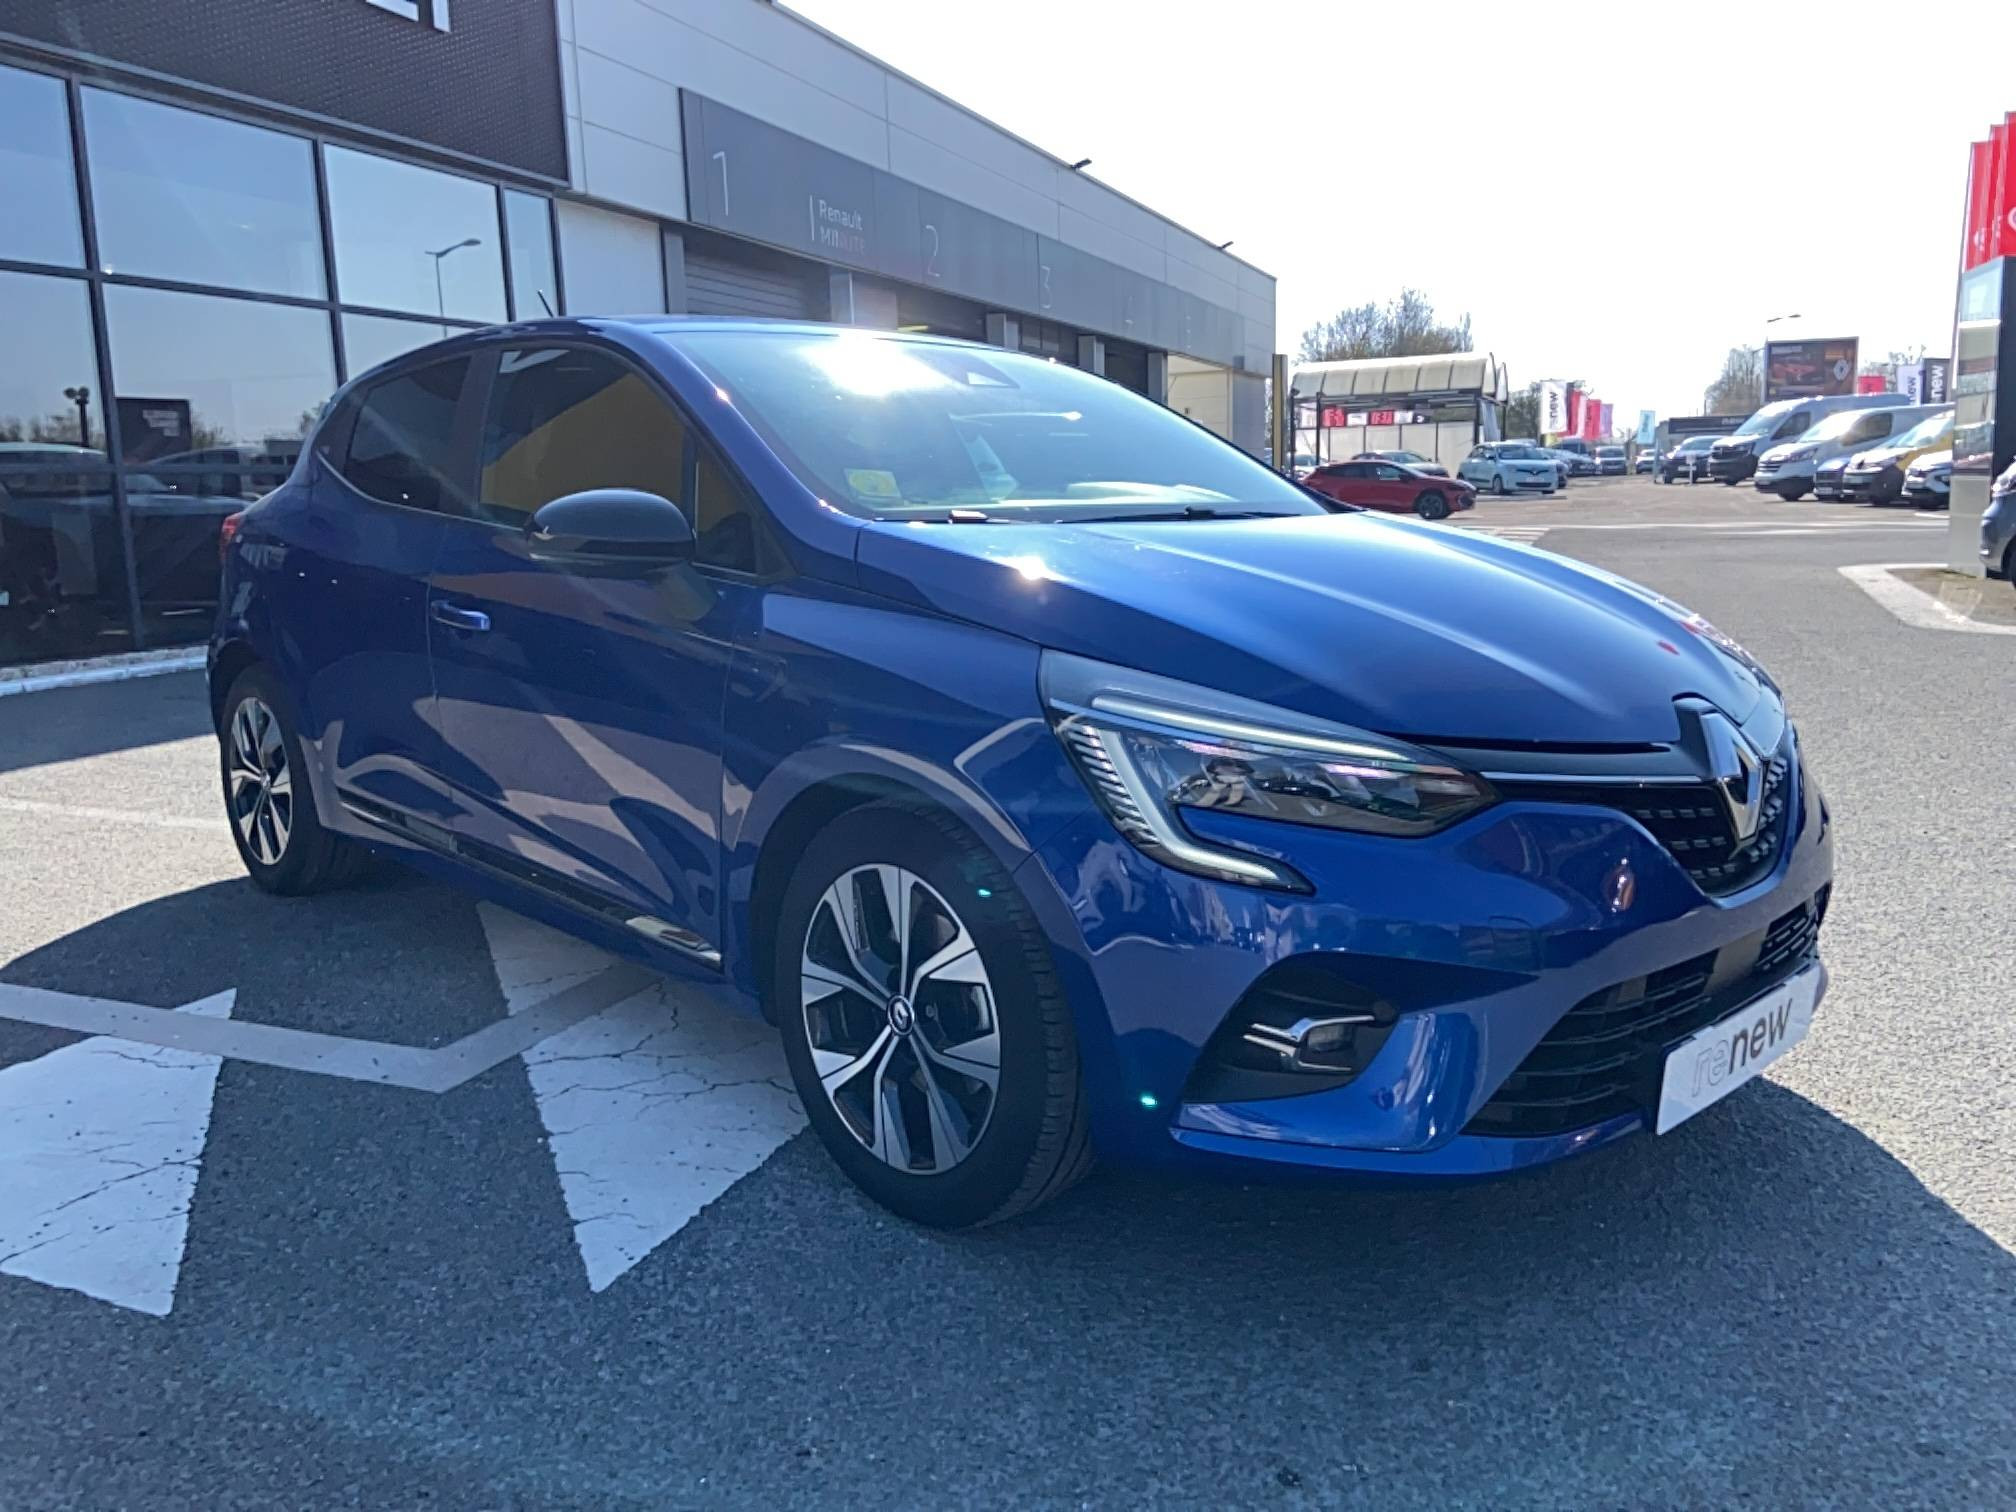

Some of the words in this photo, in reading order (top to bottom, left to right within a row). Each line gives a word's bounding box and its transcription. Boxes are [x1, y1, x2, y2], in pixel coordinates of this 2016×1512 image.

[712, 151, 729, 216] 1
[818, 199, 863, 231] Renault
[925, 224, 941, 277] 2
[1691, 998, 1793, 1098] renew
